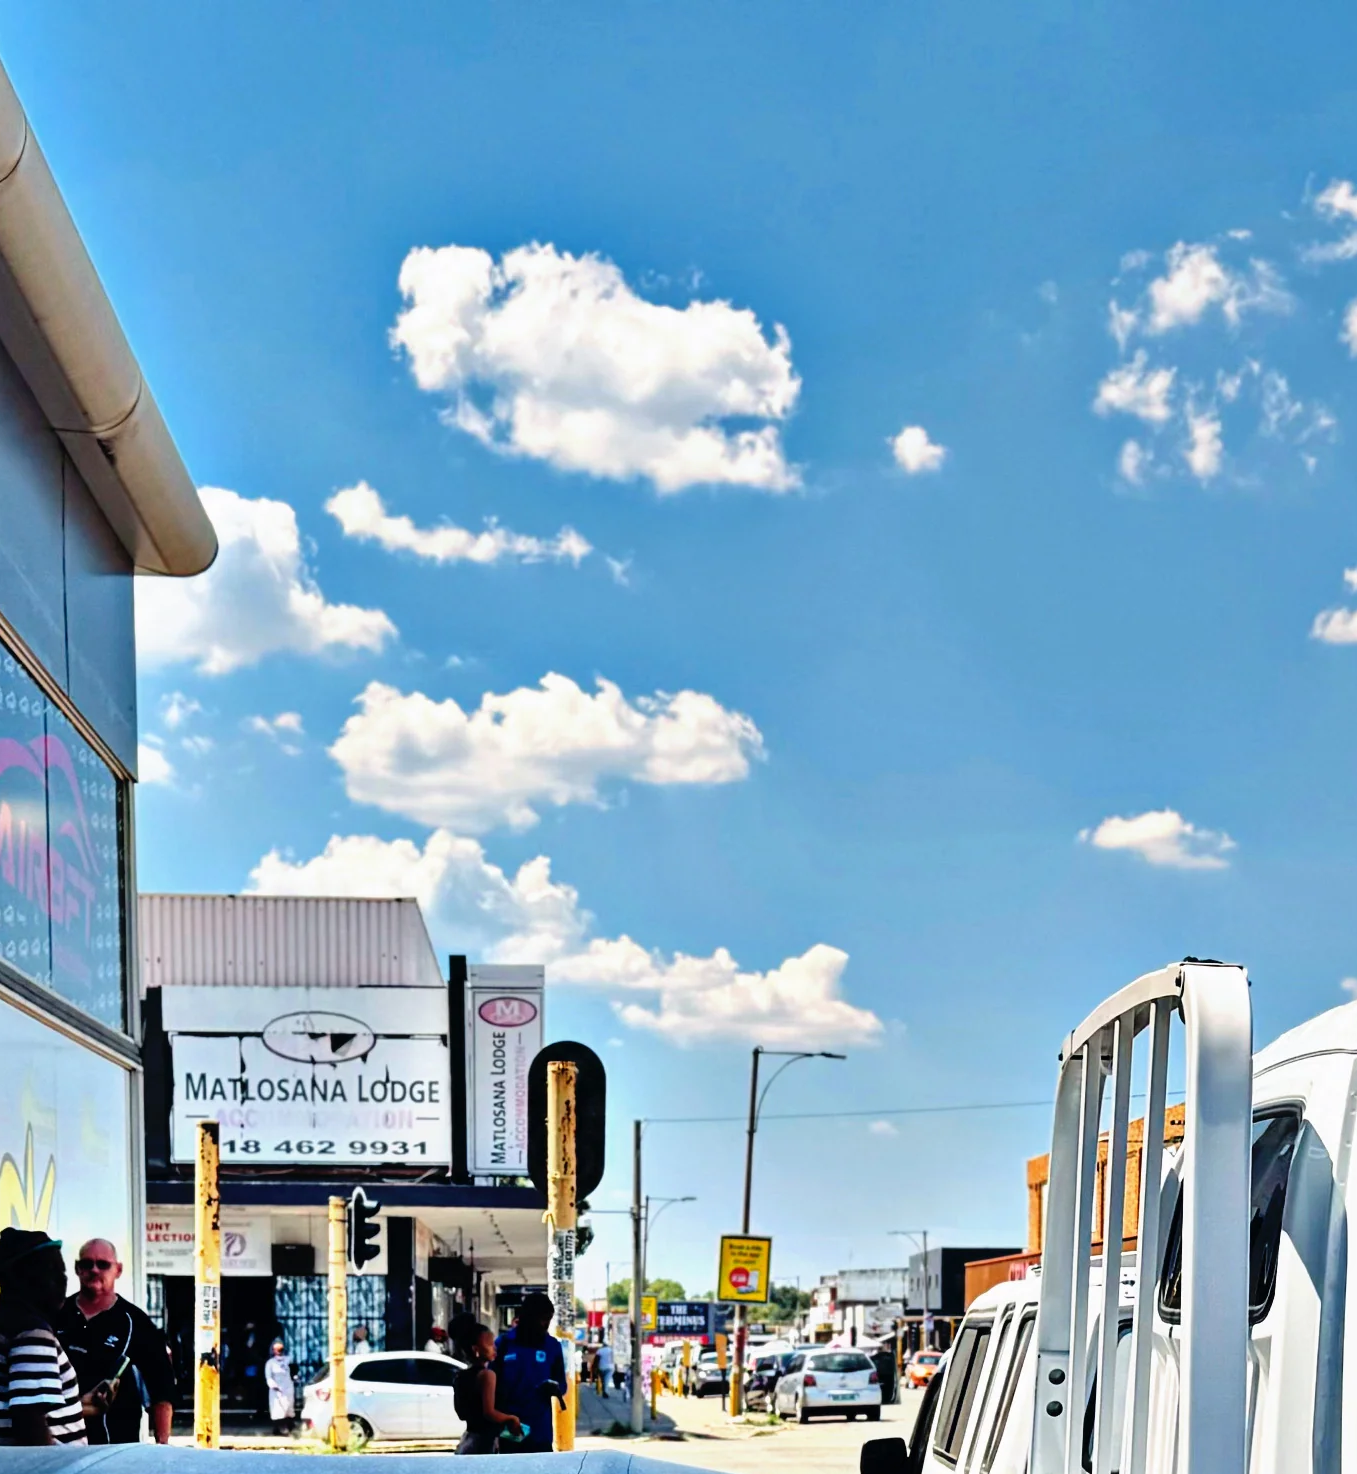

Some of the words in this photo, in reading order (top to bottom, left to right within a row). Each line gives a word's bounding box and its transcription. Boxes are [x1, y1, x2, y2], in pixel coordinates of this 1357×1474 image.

[490, 1031, 507, 1076] LODGE
[185, 1073, 347, 1102] MATLOSANA
[358, 1075, 441, 1104] LODGE
[490, 1079, 507, 1164] MATLOSANA
[274, 1140, 336, 1155] 462
[348, 1140, 428, 1156] 9931
[657, 1315, 706, 1326] ERMINUS
